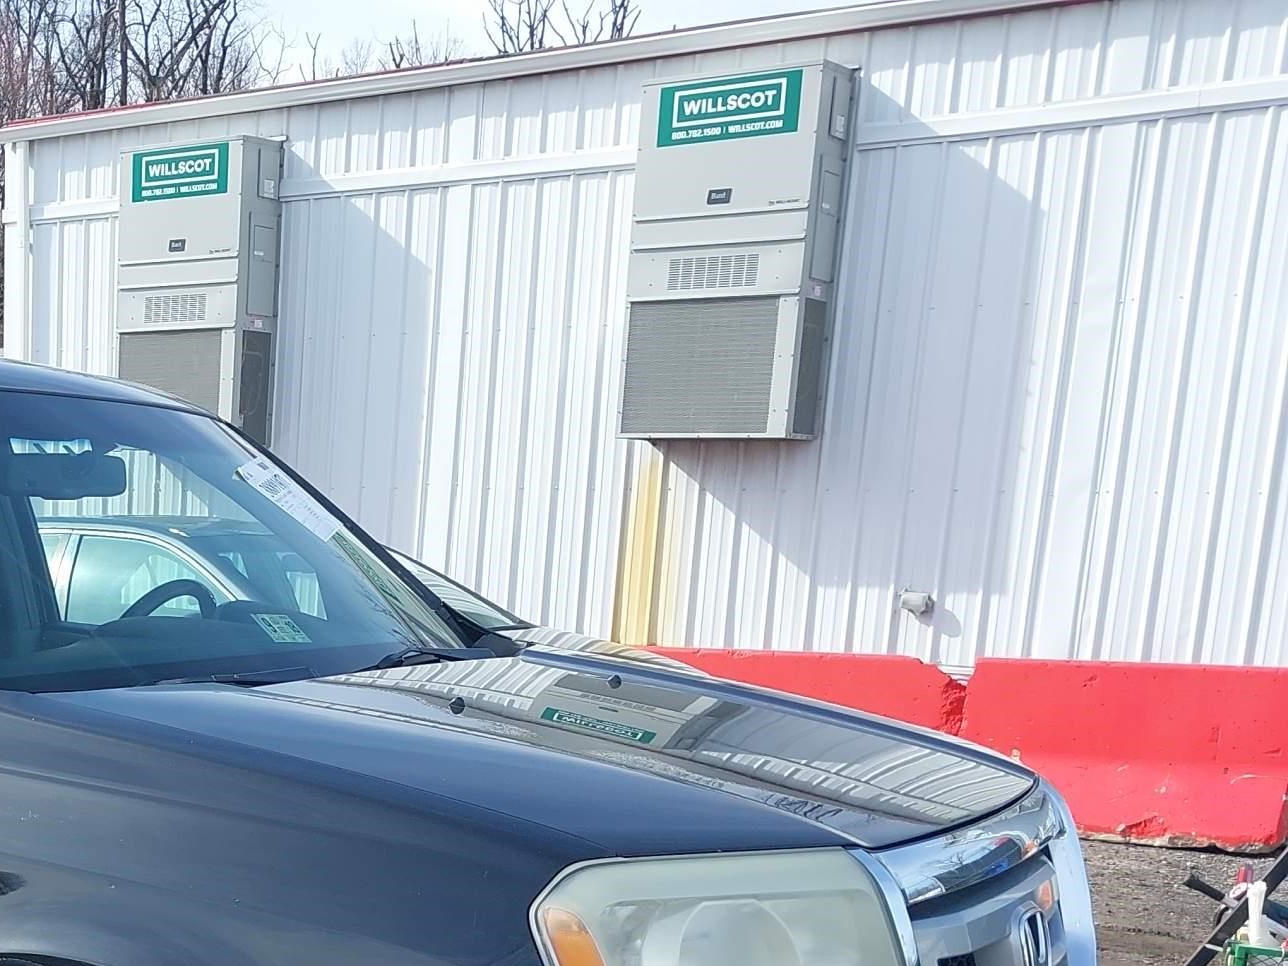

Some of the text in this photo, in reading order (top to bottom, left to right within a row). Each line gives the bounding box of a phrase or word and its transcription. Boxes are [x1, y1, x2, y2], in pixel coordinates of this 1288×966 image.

[683, 90, 777, 115] WILLSCOT
[728, 120, 783, 133] WILLSCOT.COM
[148, 158, 212, 177] WILLSCOT
